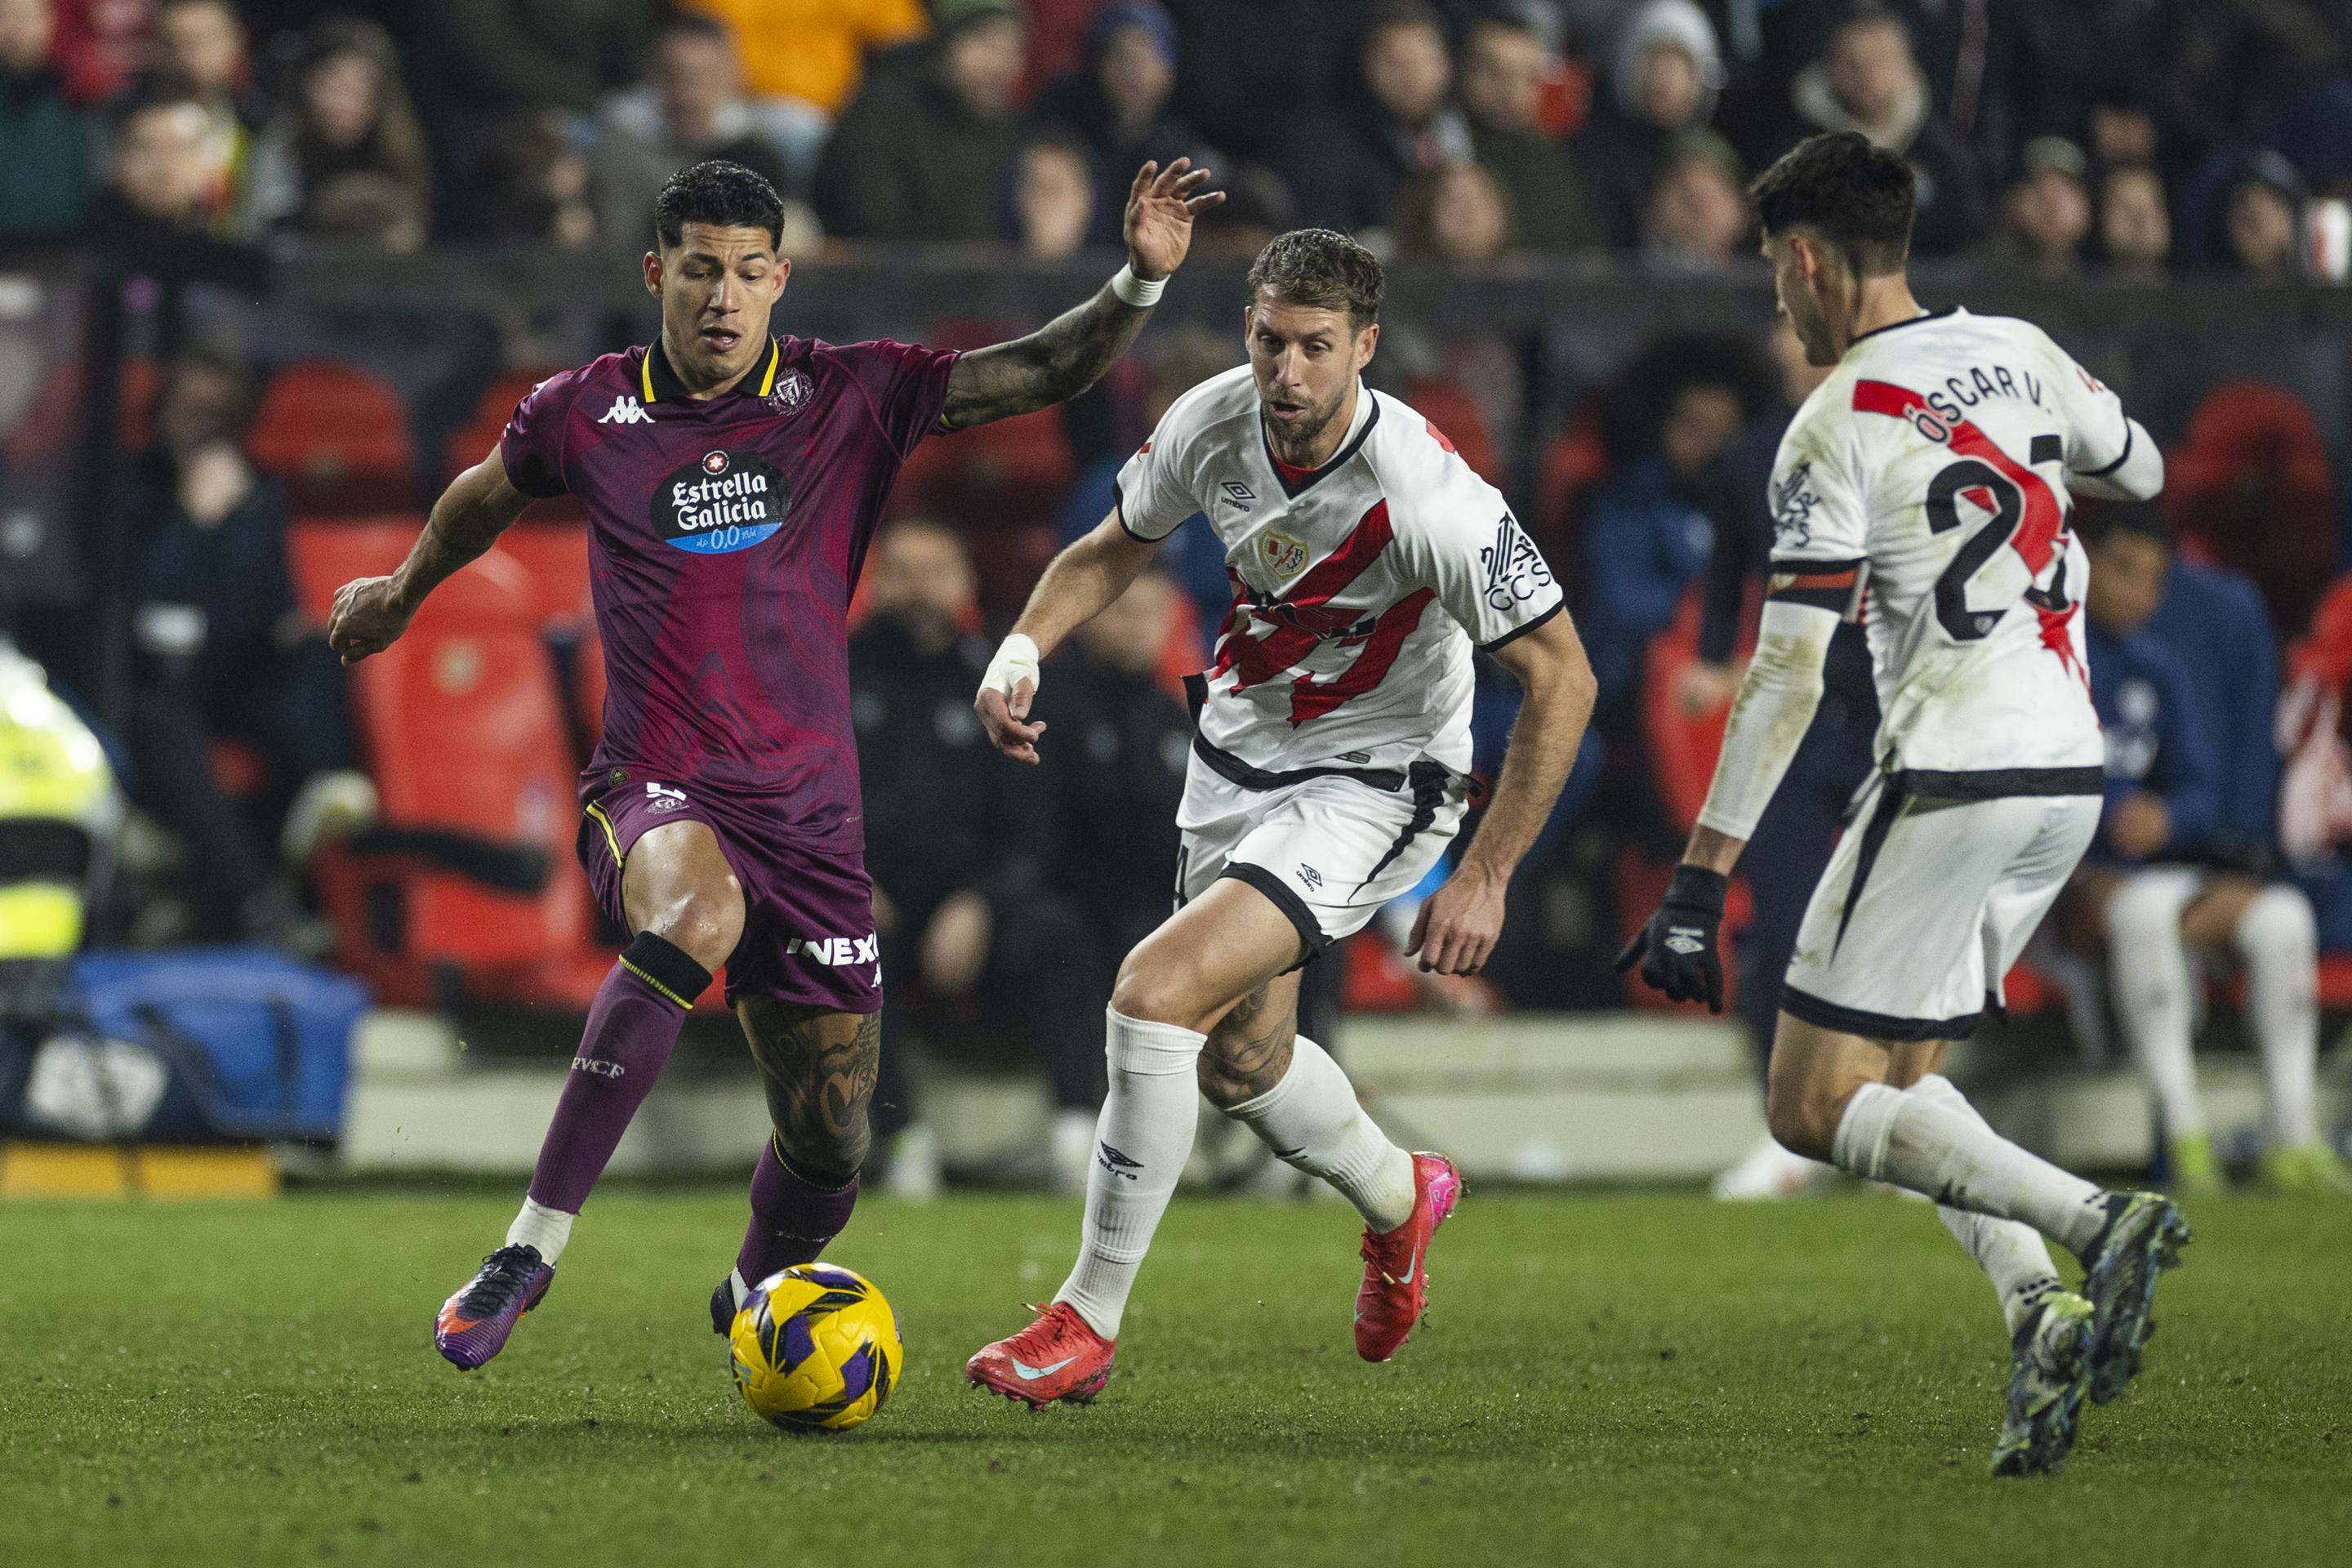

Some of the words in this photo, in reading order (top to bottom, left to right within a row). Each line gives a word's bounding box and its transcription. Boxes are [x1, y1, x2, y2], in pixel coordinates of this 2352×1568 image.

[671, 471, 768, 507] Estrella
[677, 496, 768, 531] Galicia
[1221, 497, 1250, 513] umbro
[710, 525, 740, 550] 0,0
[1489, 561, 1552, 611] GCS
[1295, 870, 1316, 893] umbro
